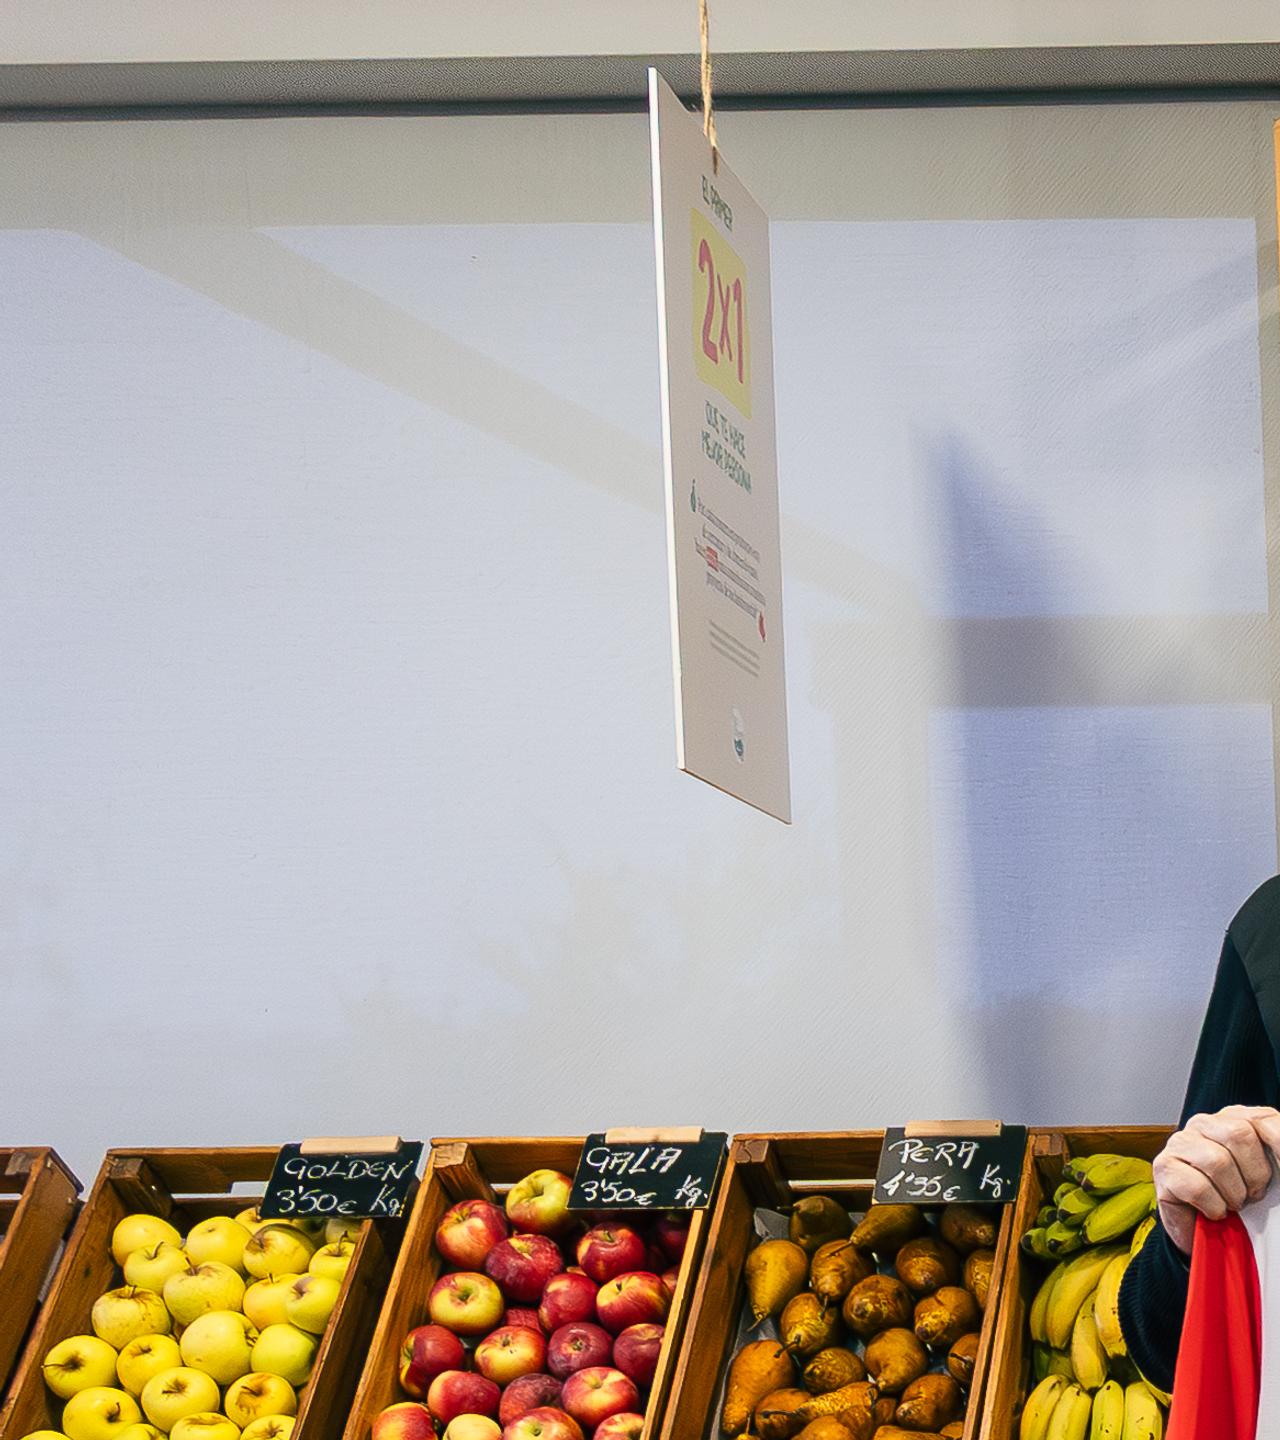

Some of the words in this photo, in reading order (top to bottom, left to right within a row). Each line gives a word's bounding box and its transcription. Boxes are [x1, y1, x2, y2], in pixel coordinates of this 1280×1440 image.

[585, 1147, 683, 1174] GALA
[887, 1138, 980, 1168] PERA
[284, 1156, 413, 1182] GOLDEN
[276, 1187, 357, 1215] 3'50€
[580, 1178, 658, 1208] 3'50€
